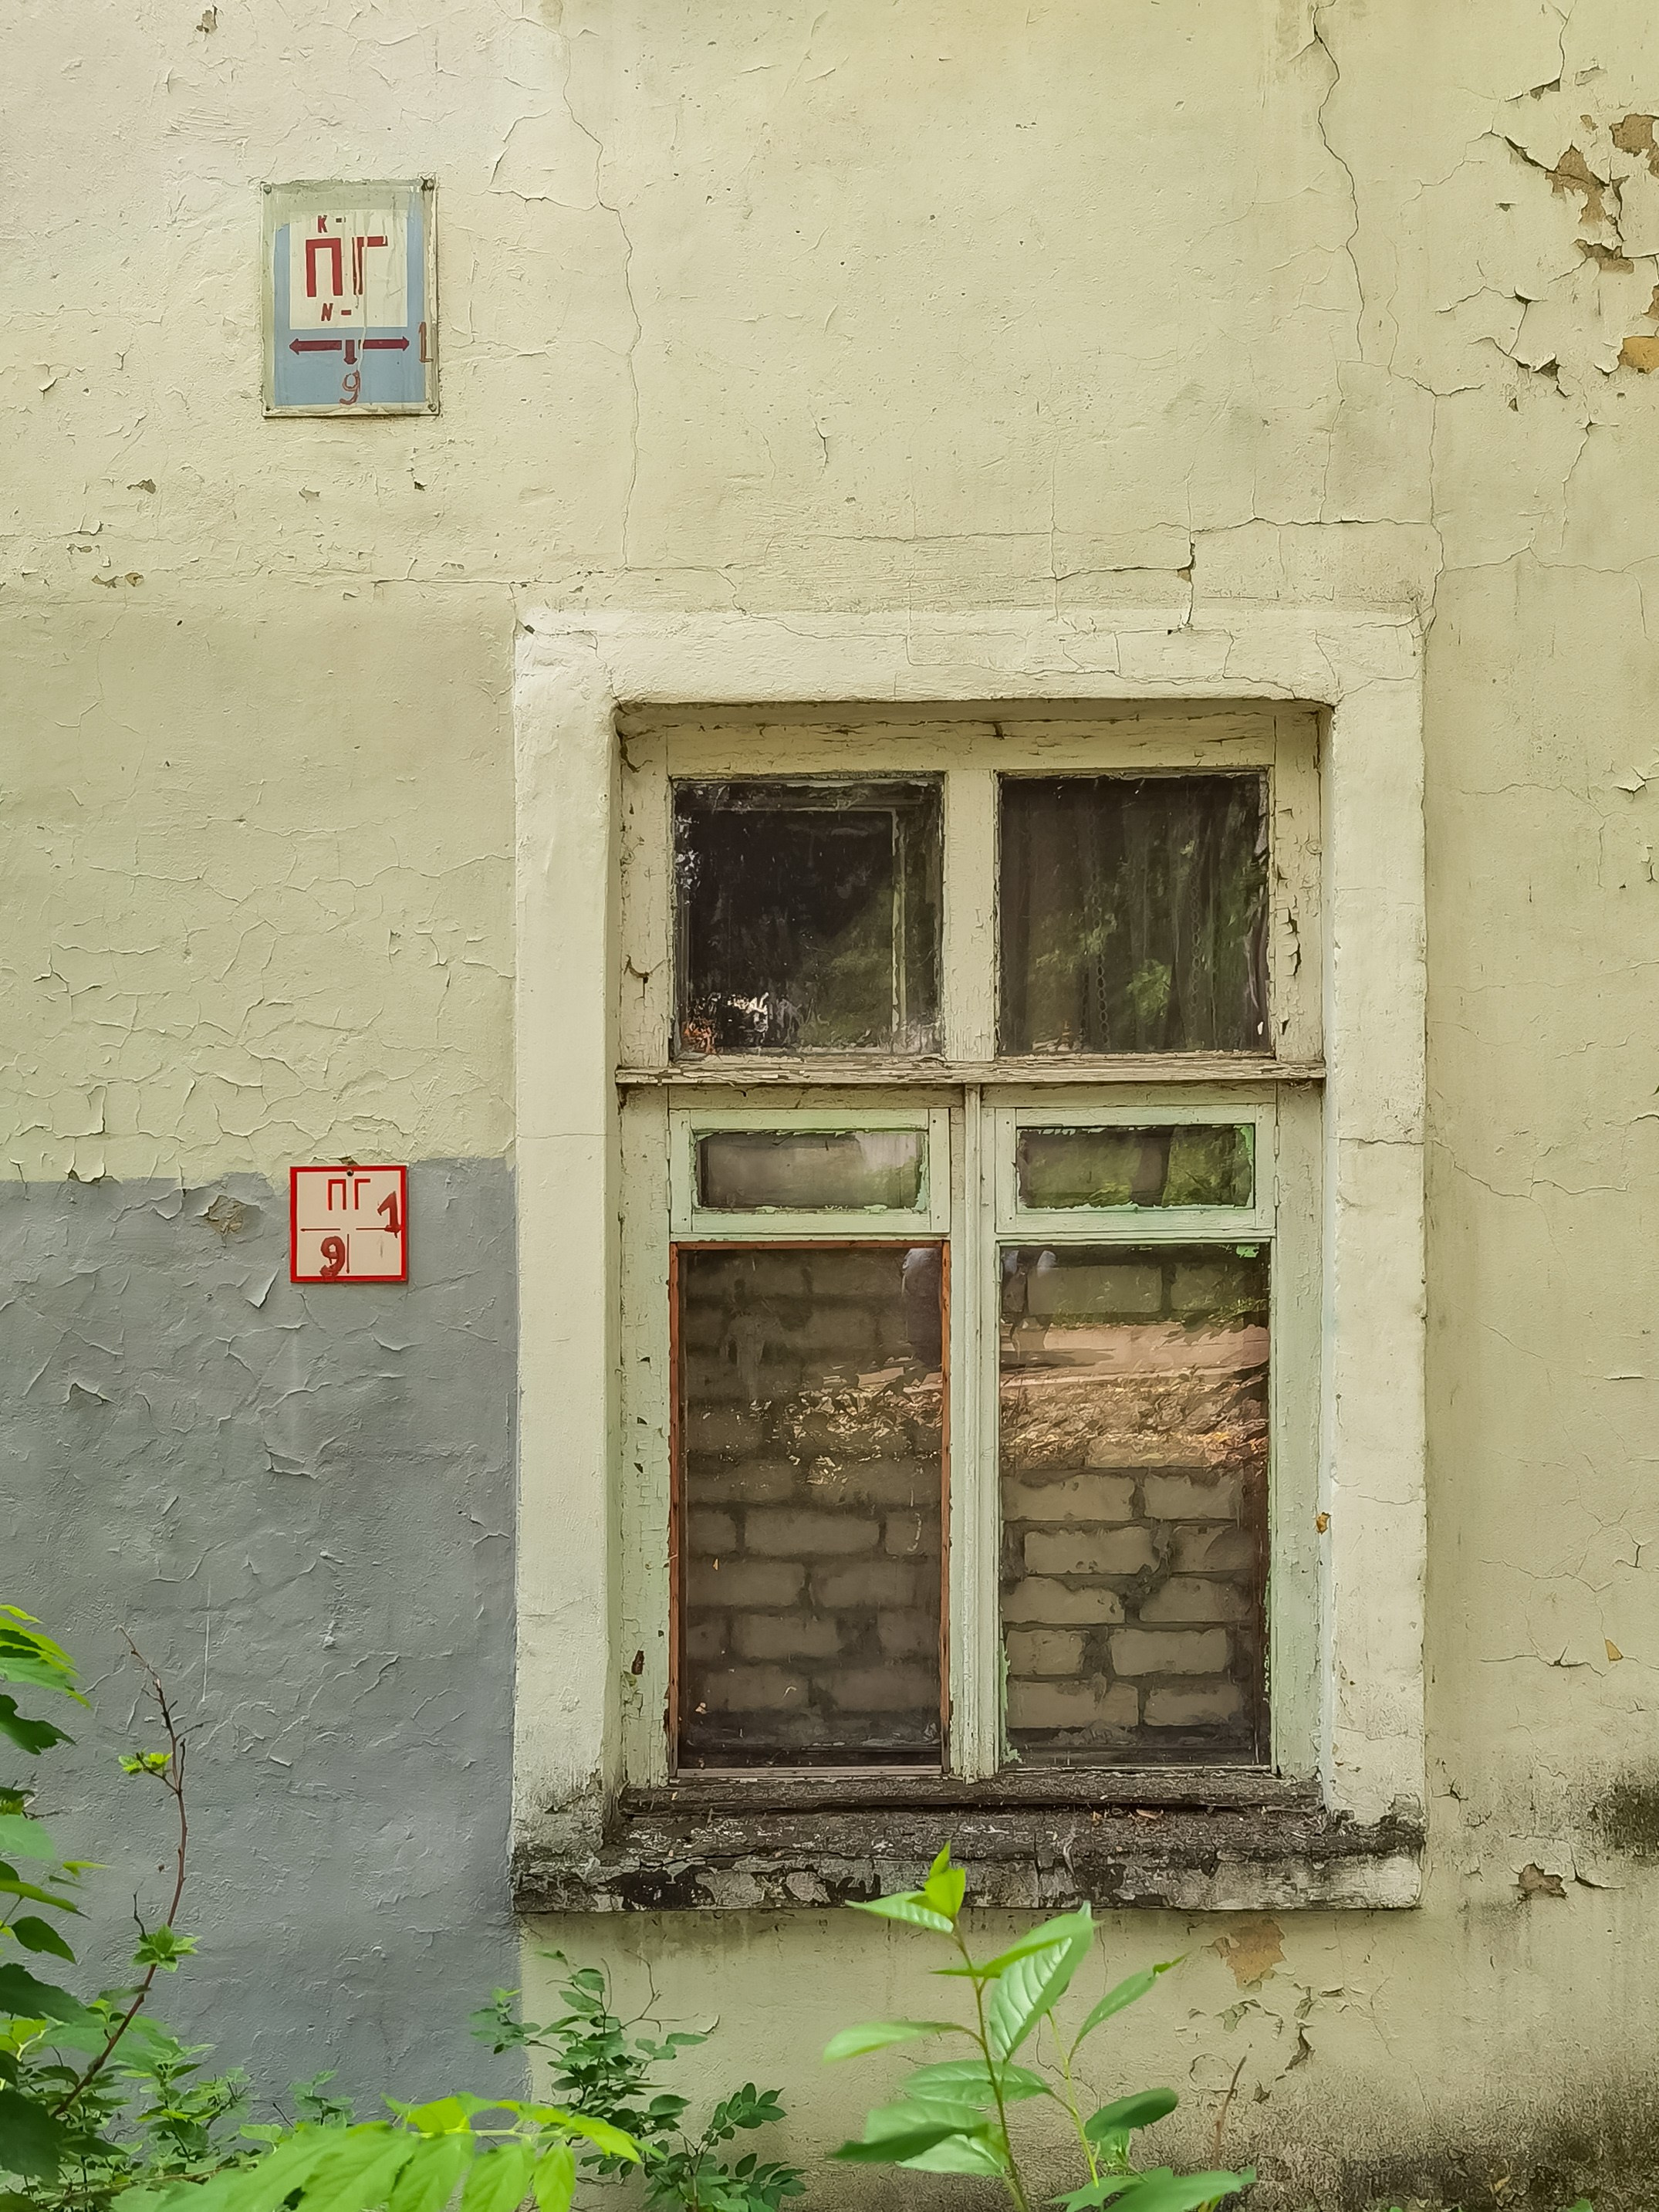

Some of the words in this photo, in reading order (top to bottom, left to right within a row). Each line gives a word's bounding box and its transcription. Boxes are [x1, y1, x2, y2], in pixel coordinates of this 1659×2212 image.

[306, 235, 388, 297] ПГ
[340, 370, 360, 405] 9
[328, 1179, 371, 1211] ПГ
[377, 1191, 401, 1239] 1
[319, 1236, 346, 1280] 9
